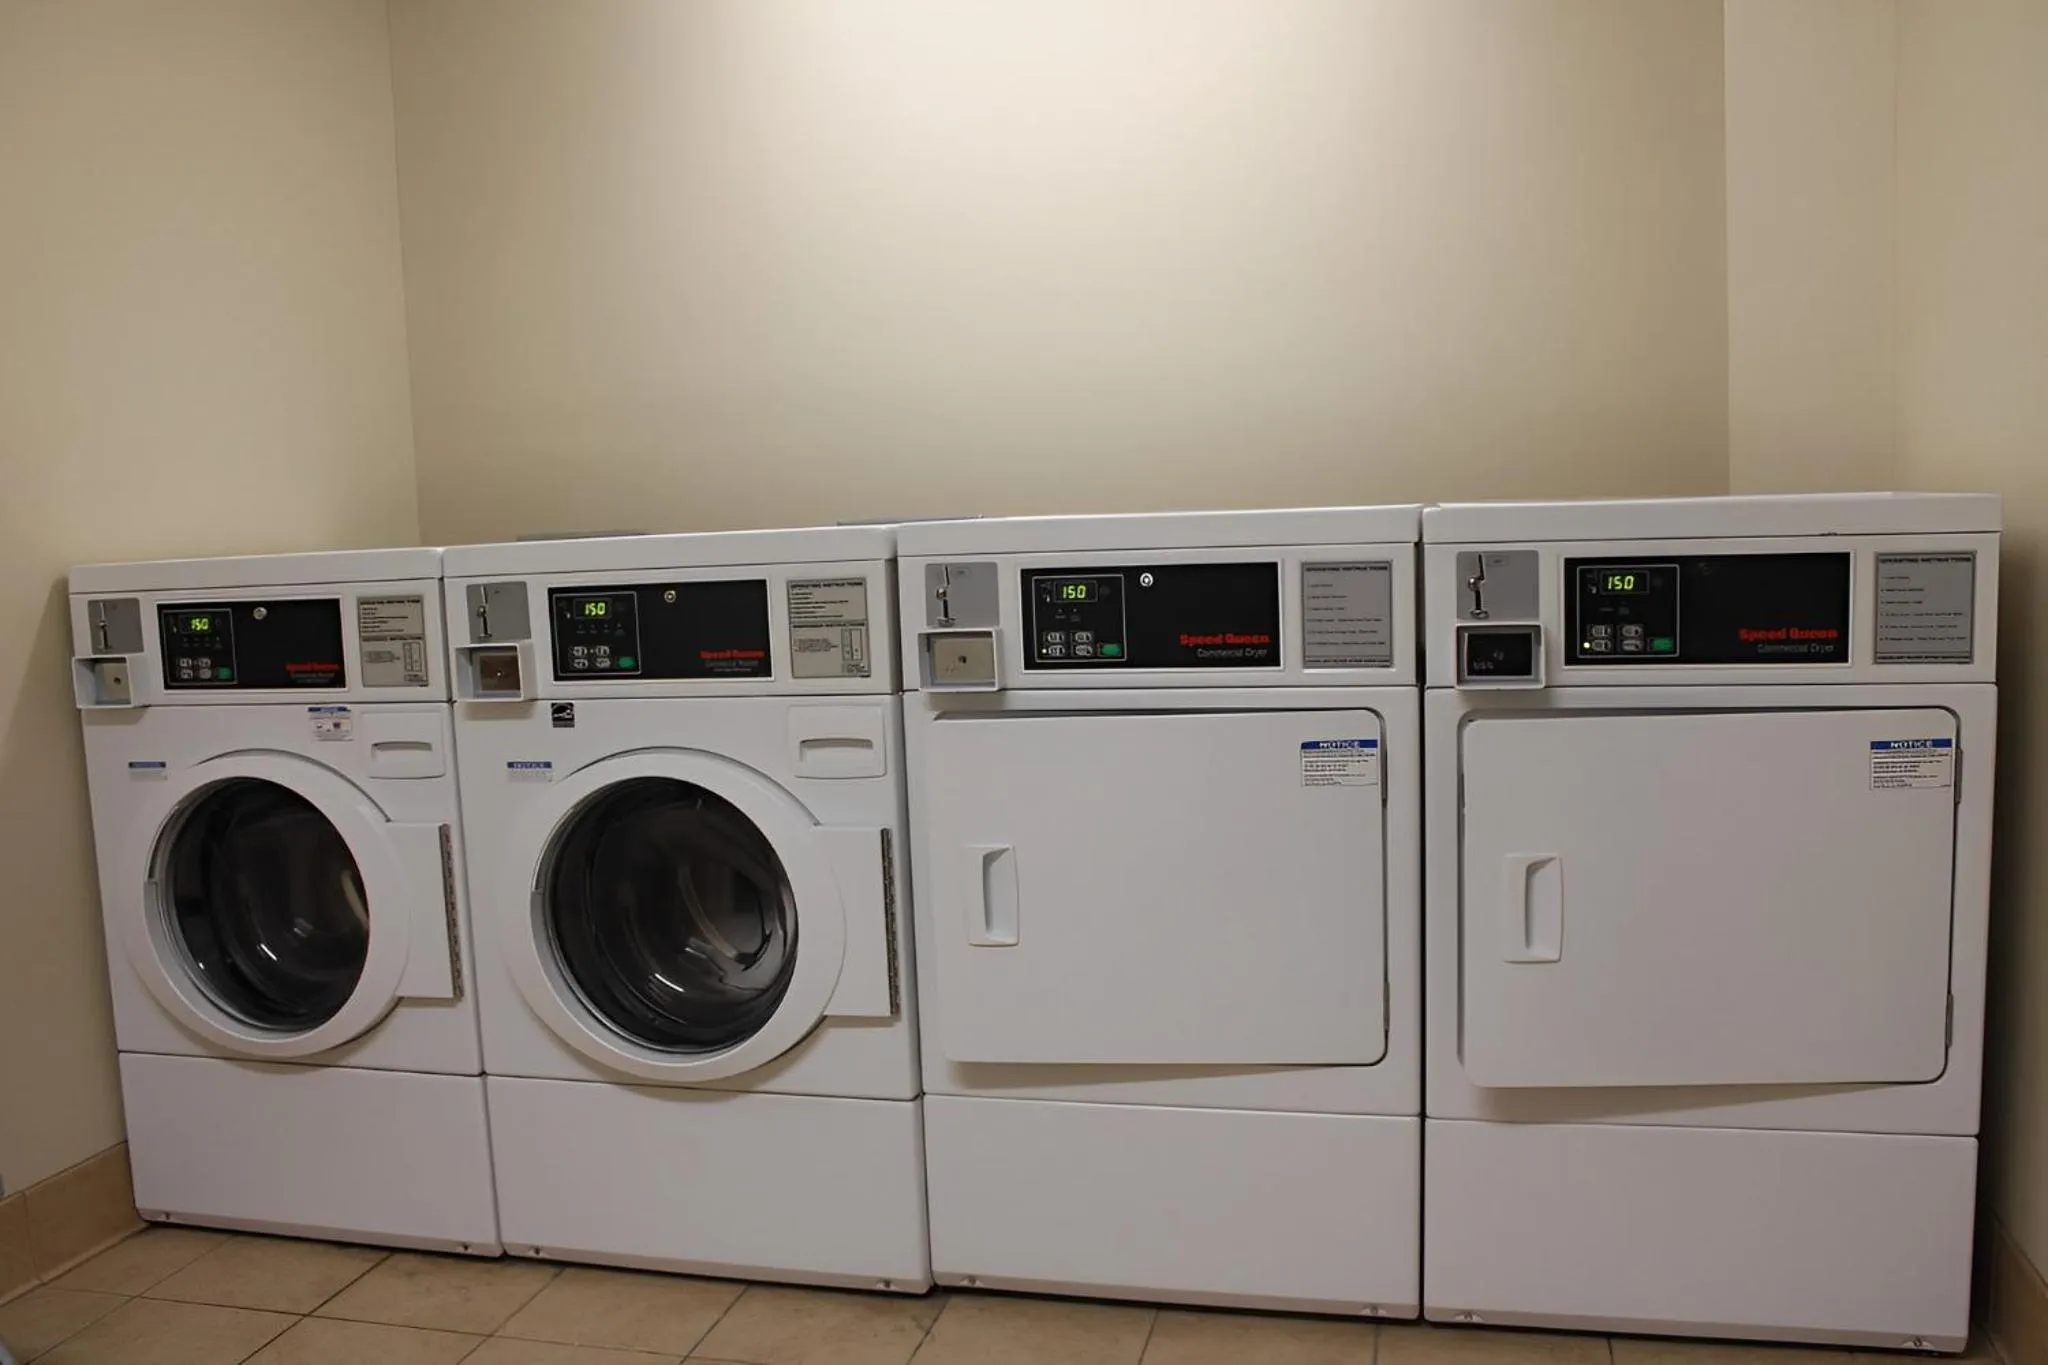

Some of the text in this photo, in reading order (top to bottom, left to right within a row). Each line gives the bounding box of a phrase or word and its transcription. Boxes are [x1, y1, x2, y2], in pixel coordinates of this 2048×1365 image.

[1607, 575, 1634, 590] 150
[1062, 585, 1087, 599] 150
[584, 602, 606, 616] 150
[190, 617, 209, 631] 150
[1179, 632, 1270, 646] Speed Queen
[1738, 626, 1839, 641] Speed Queen
[1244, 646, 1268, 659] Dryer
[1320, 740, 1360, 749] NOTICE
[1890, 740, 1933, 749] NOTICE
